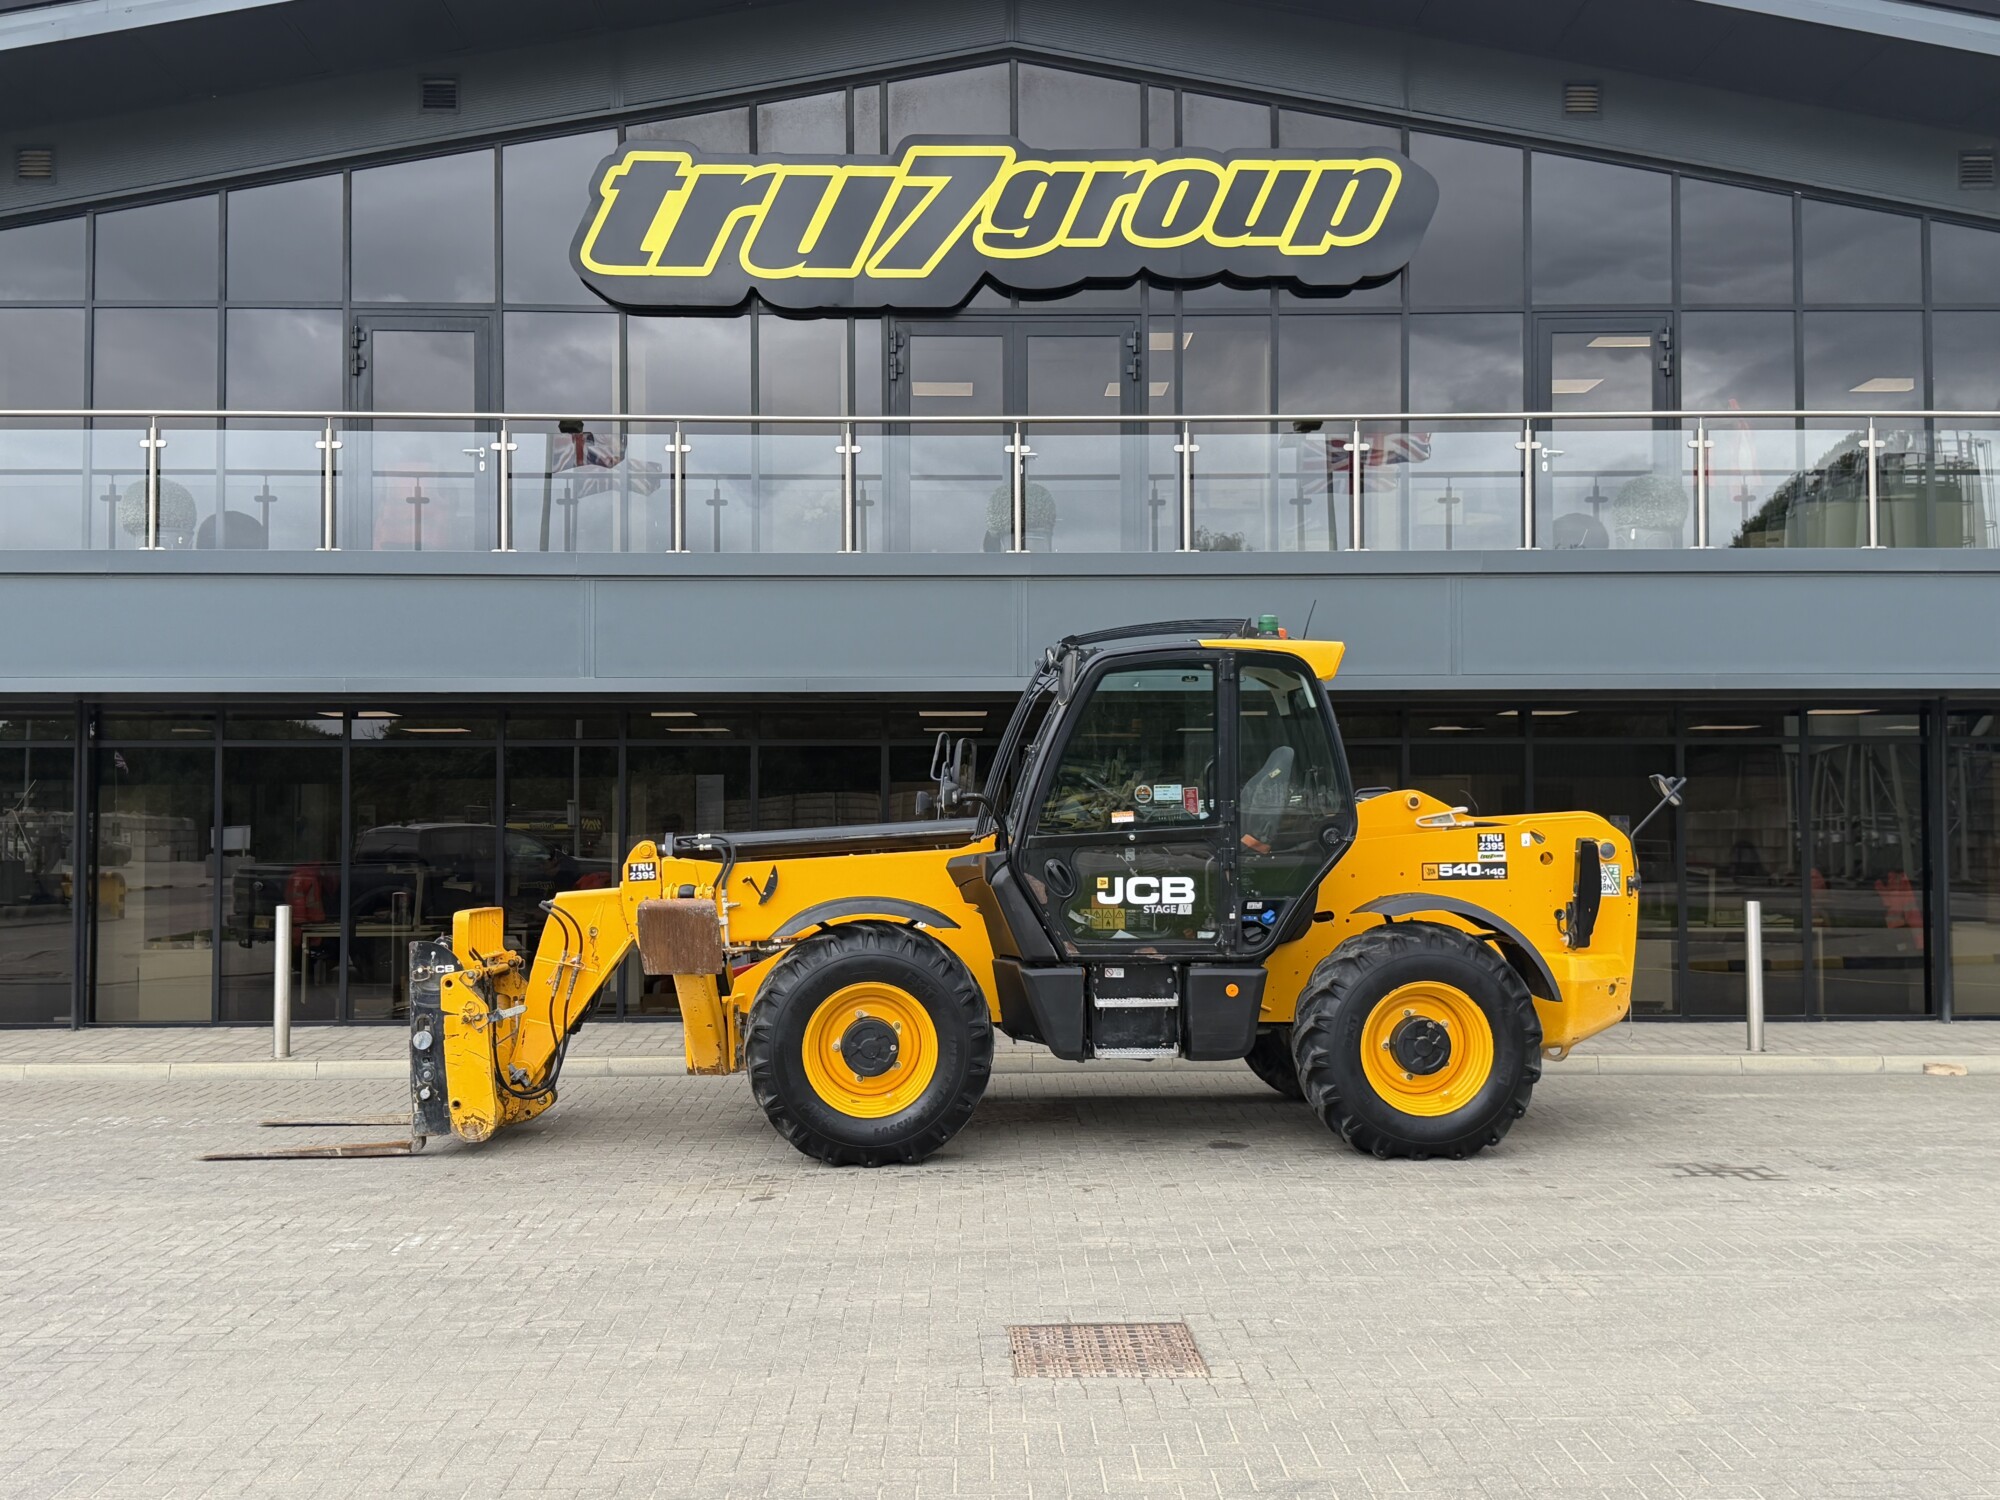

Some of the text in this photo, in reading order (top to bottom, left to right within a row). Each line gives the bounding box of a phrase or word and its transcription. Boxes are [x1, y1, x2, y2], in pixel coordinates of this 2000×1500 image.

[1479, 834, 1503, 842] TRU
[1478, 842, 1504, 851] 2395
[630, 863, 653, 872] TRU
[1438, 862, 1506, 877] 540-140
[629, 871, 656, 881] 2395
[1096, 876, 1196, 905] JCB
[1143, 904, 1177, 914] STAGE
